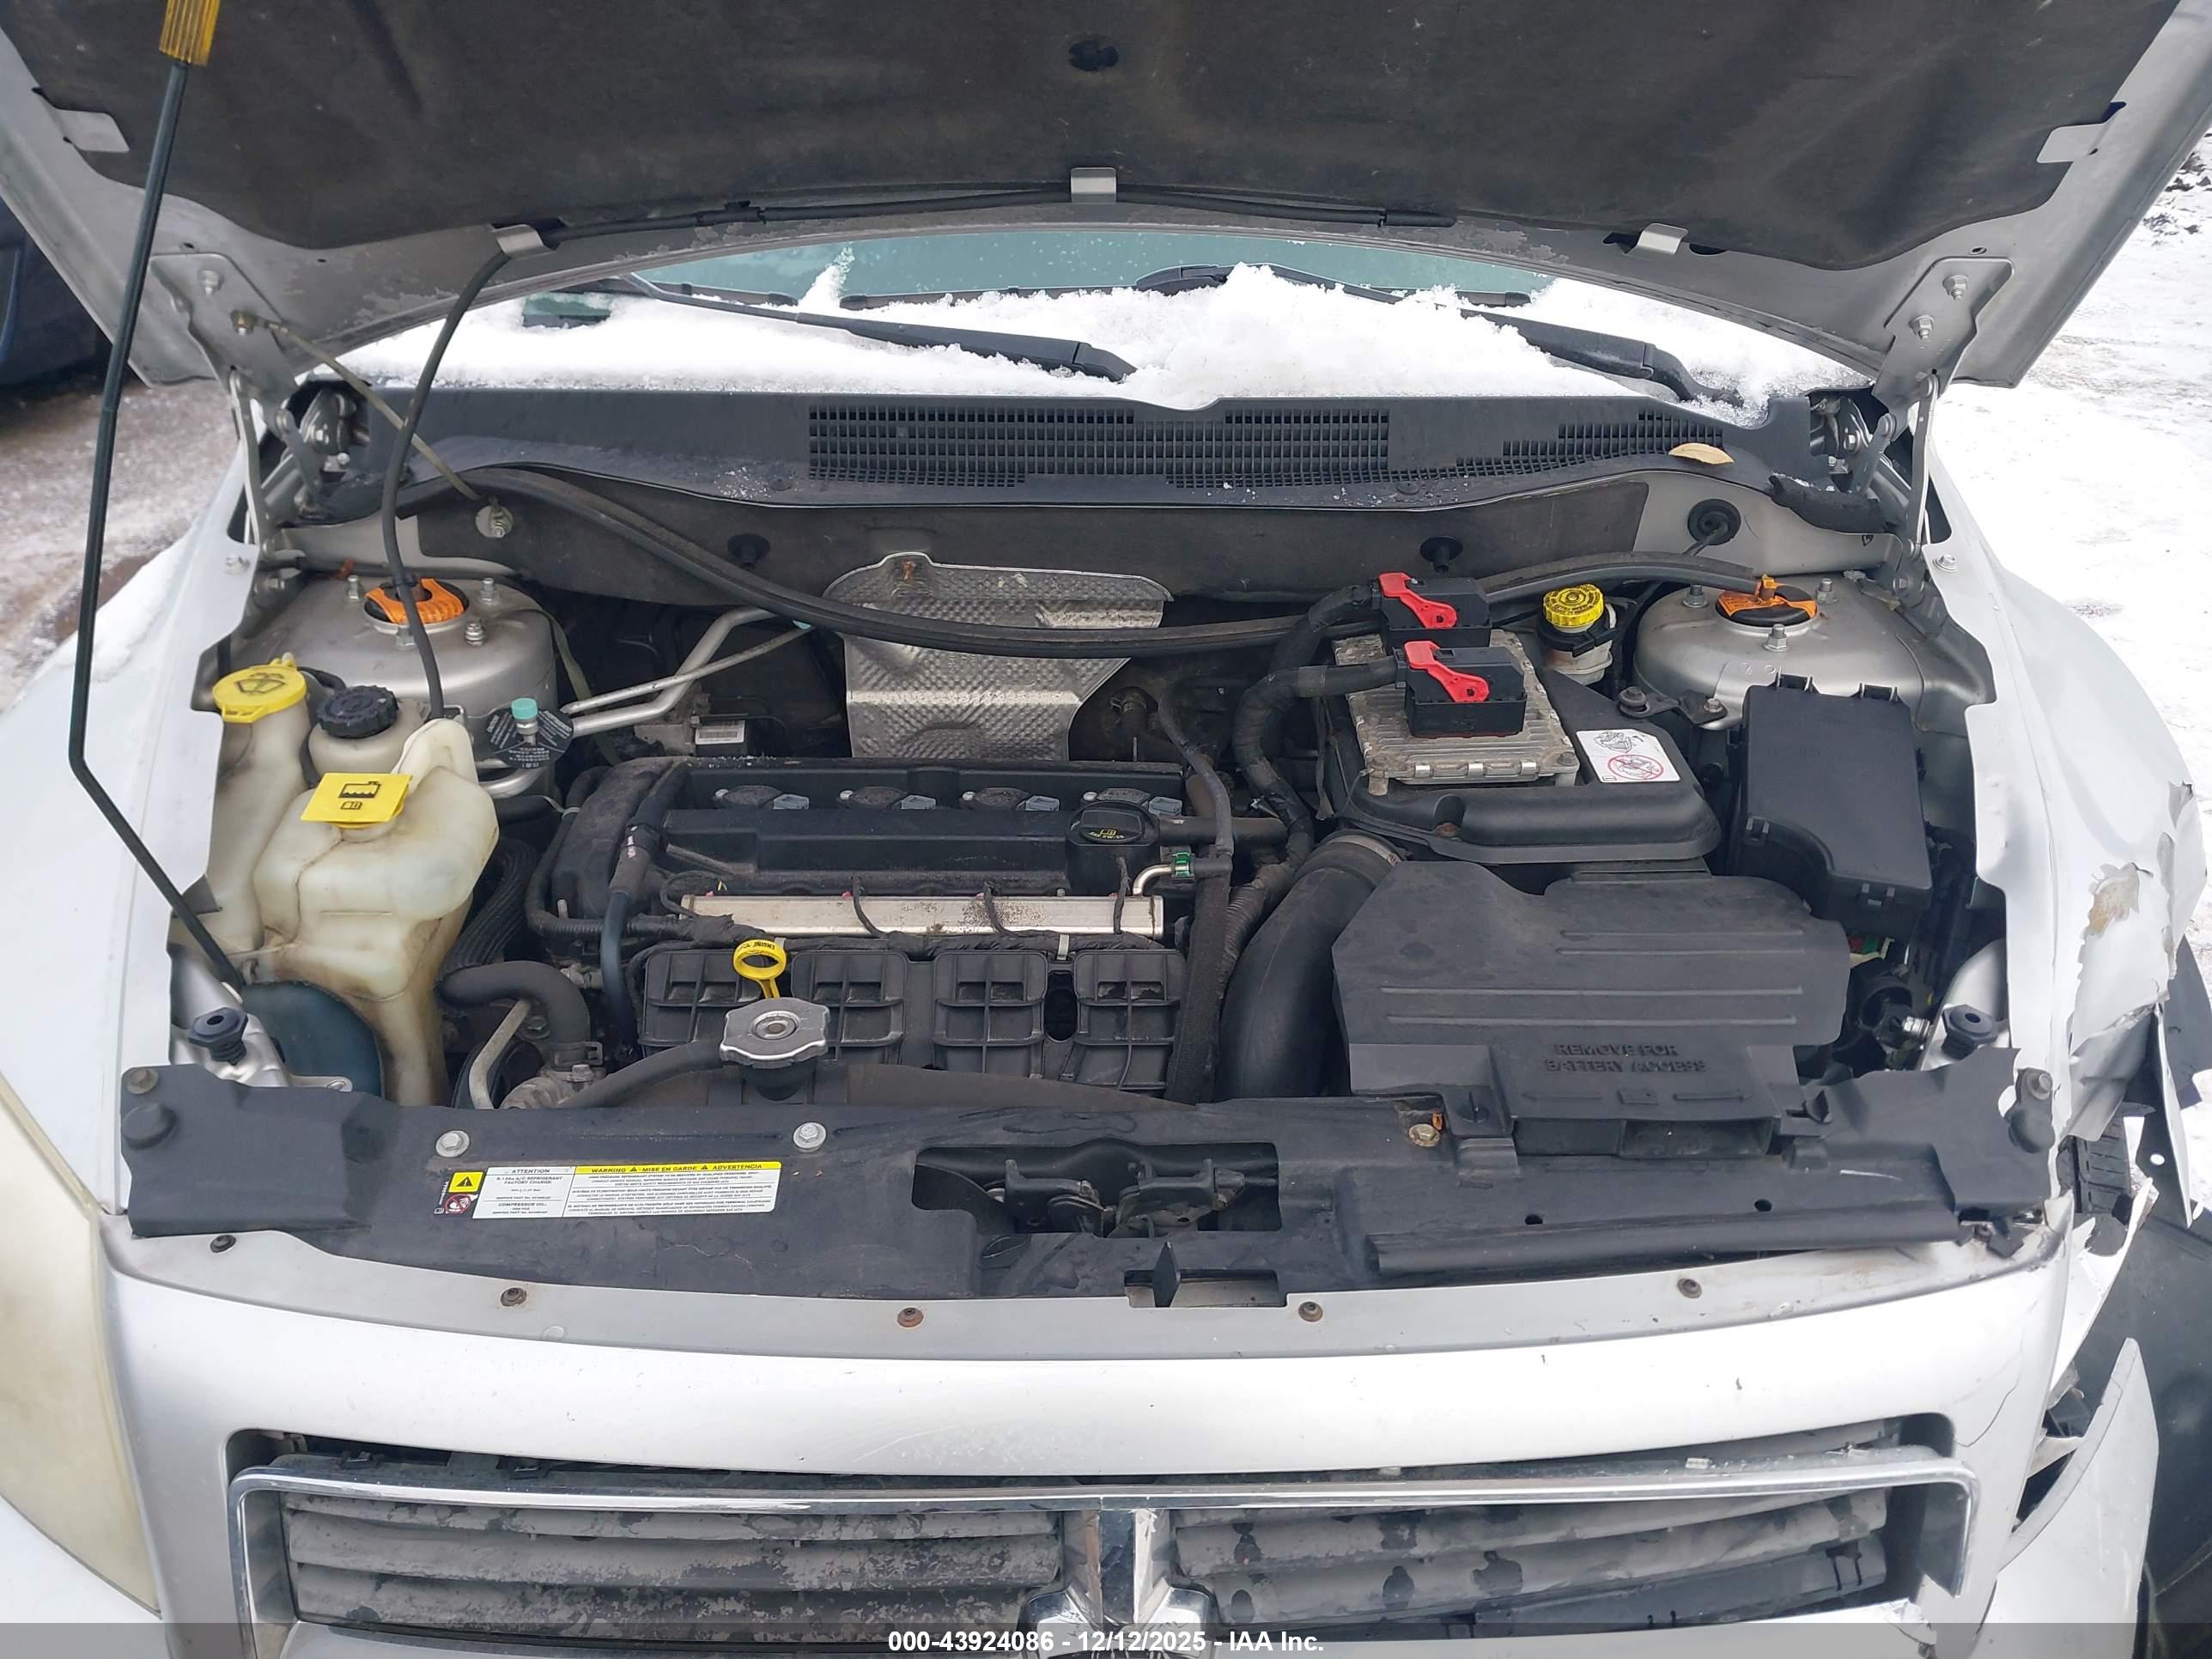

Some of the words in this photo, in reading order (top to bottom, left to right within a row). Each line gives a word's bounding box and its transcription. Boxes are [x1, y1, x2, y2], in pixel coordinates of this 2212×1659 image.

[752, 940, 775, 950] ENGINE
[1555, 1043, 1635, 1055] REMOVE
[1638, 1043, 1680, 1056] FOR
[1544, 1059, 1624, 1073] BATTERY
[1631, 1059, 1708, 1073] ACCESS
